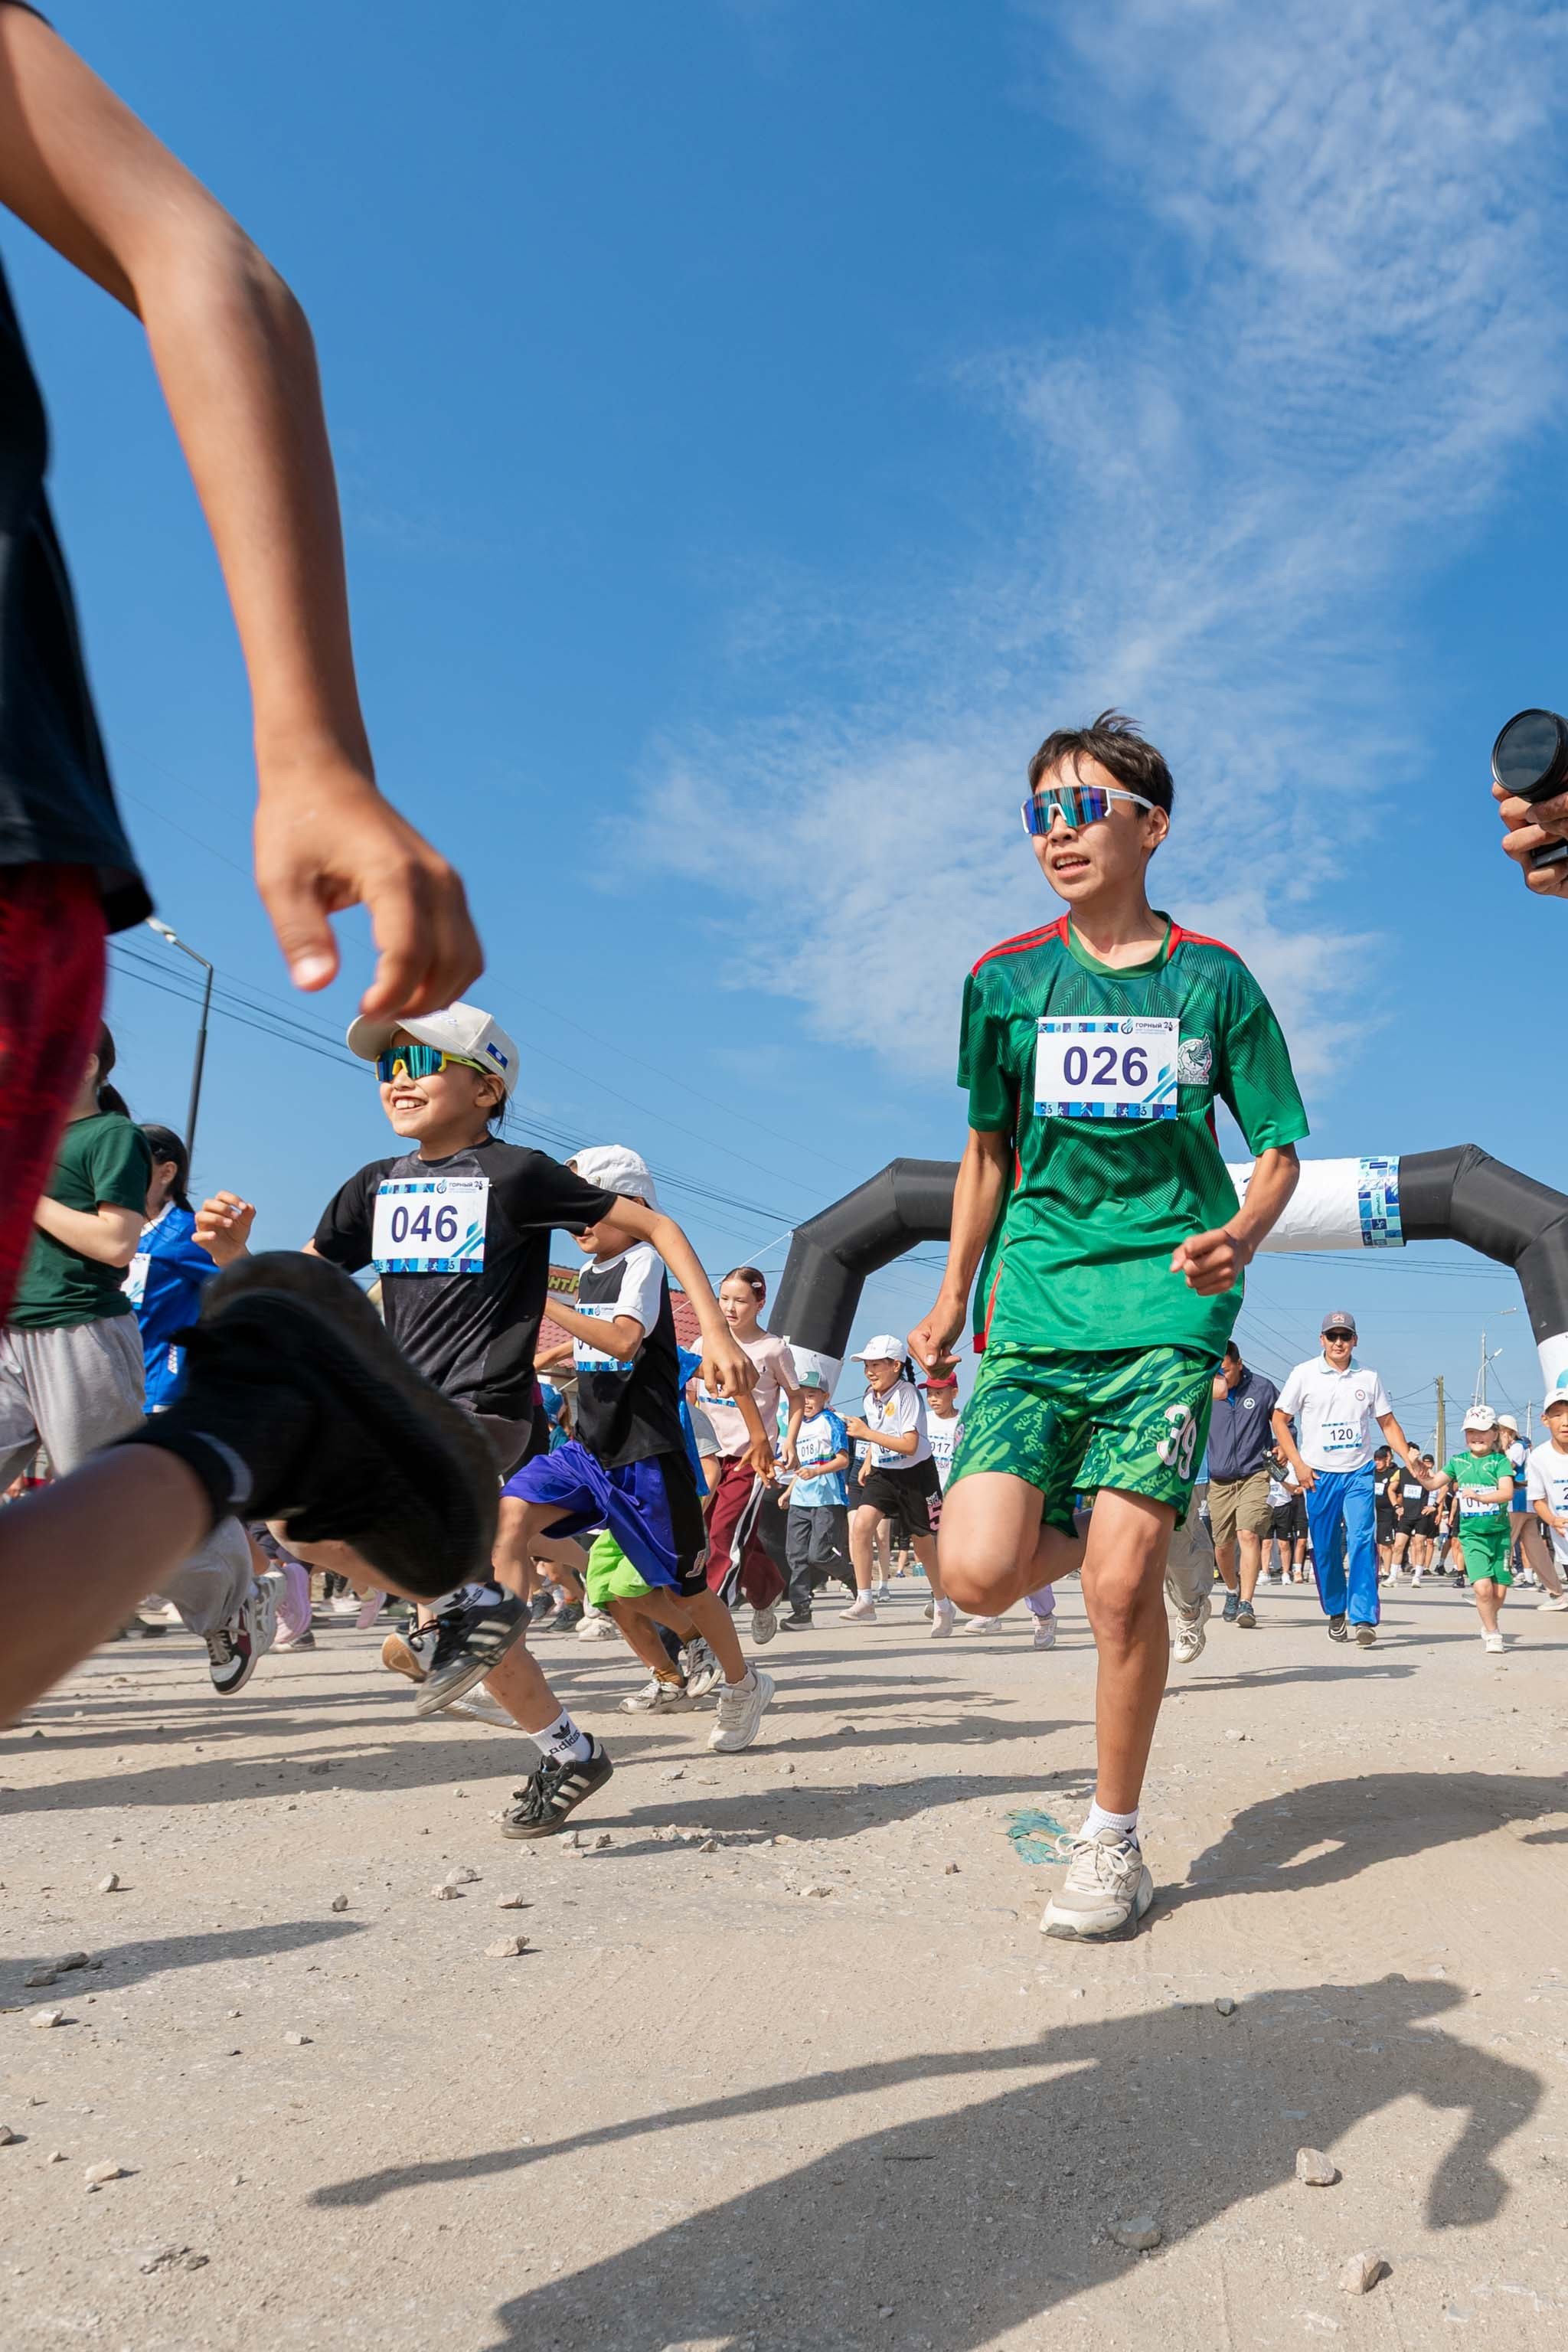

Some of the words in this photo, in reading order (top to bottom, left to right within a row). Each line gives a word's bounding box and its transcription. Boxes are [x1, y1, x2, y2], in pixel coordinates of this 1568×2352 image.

[1063, 1046, 1148, 1087] 026
[391, 1204, 459, 1243] 046
[1156, 1404, 1197, 1479] 39
[1330, 1428, 1354, 1441] 120
[801, 1443, 815, 1457] 018
[930, 1441, 951, 1454] 017
[549, 1730, 581, 1754] adidas
